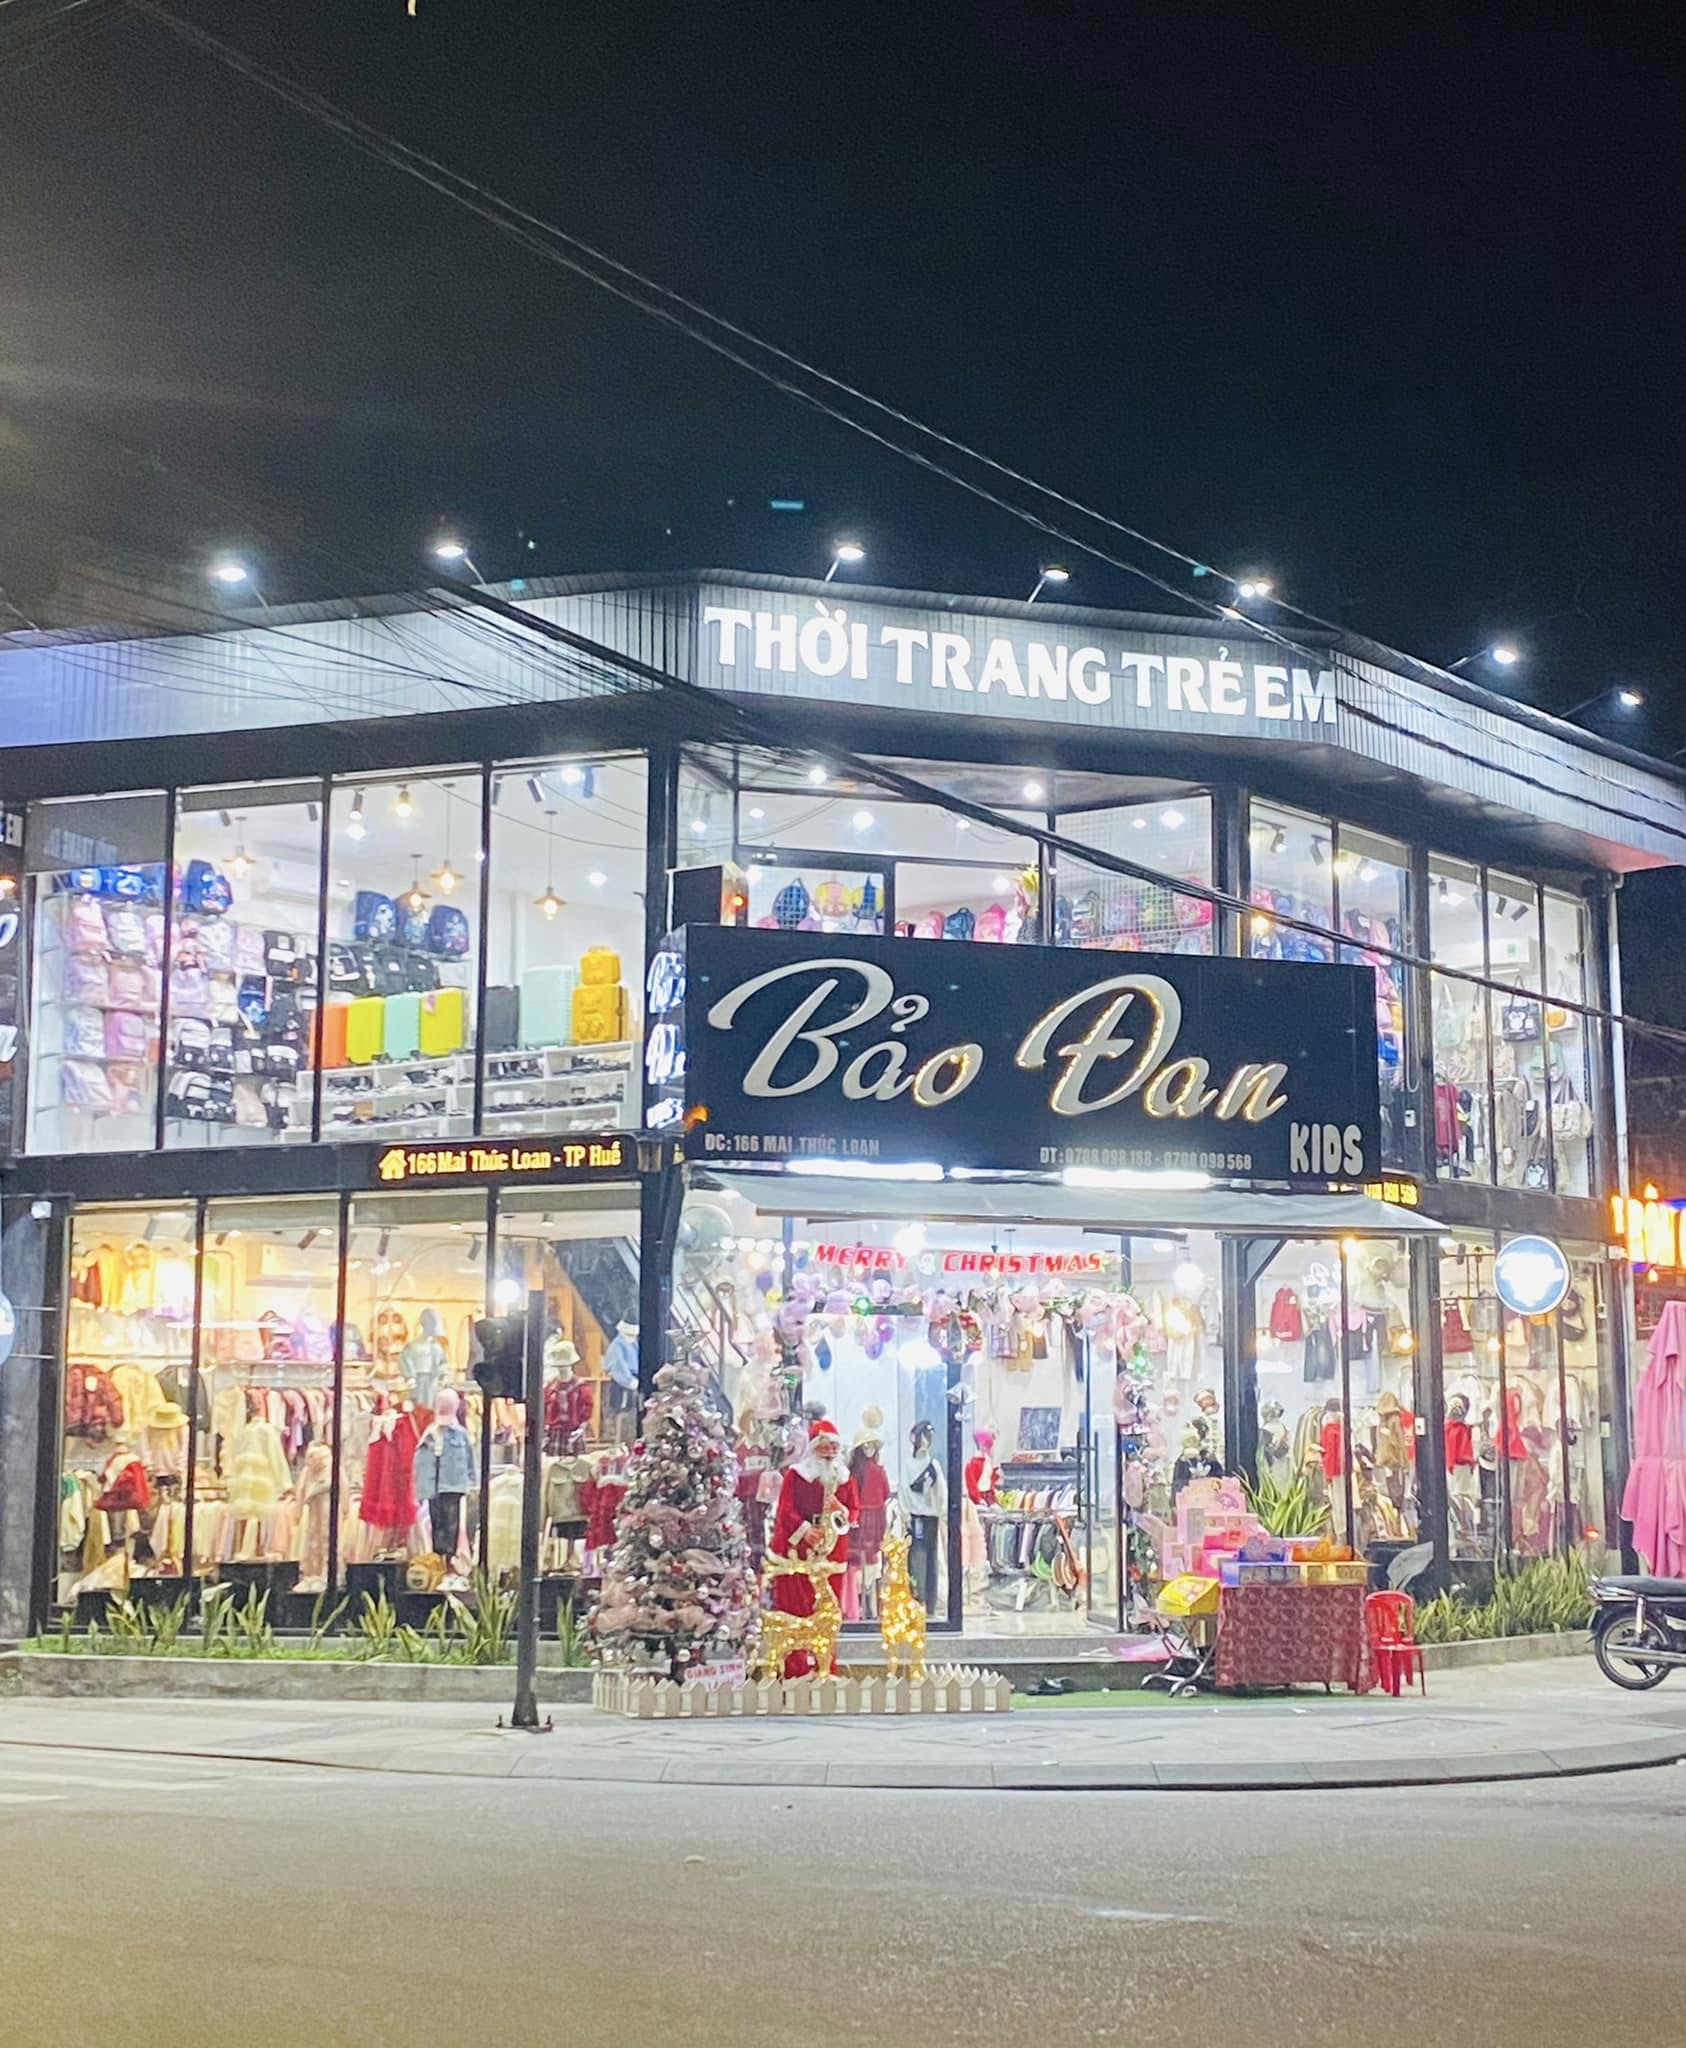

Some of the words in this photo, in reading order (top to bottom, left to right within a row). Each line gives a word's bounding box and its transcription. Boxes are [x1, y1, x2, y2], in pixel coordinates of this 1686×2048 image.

[703, 600, 868, 680] THỜI
[880, 626, 1112, 705] TRANG
[1121, 647, 1248, 716] TRẺ
[1254, 667, 1337, 724] EM
[707, 957, 985, 1107] Bảo
[1015, 973, 1290, 1122] Đan
[437, 1150, 467, 1173] Mai
[511, 1147, 551, 1170] Loan
[563, 1145, 586, 1167] TP
[589, 1140, 622, 1166] Huế
[734, 1135, 760, 1153] 166
[763, 1135, 793, 1153] MAI
[842, 1139, 880, 1156] LOAN
[1199, 1152, 1225, 1170] 098
[1227, 1153, 1252, 1170] 568
[1290, 1121, 1364, 1177] KIDS
[816, 1244, 906, 1269] MERRY
[943, 1250, 1103, 1274] CHRISTMAS
